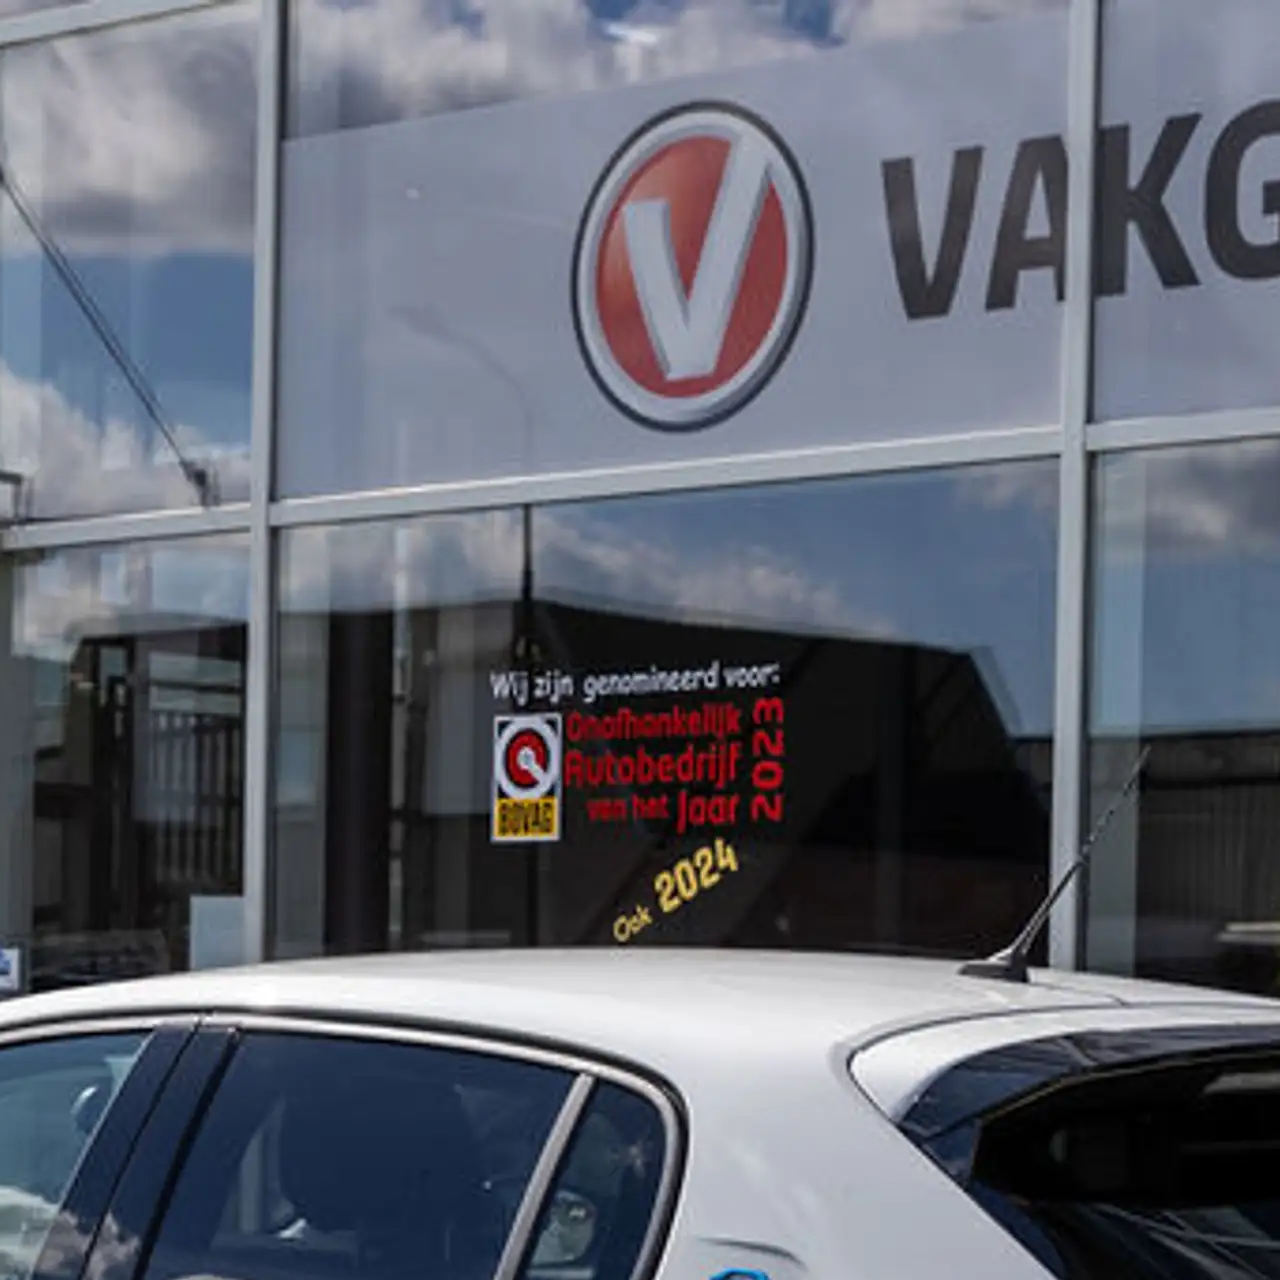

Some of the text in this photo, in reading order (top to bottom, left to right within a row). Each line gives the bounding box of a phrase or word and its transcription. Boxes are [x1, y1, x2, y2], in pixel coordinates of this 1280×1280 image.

[489, 669, 529, 705] Wij
[533, 668, 574, 704] zijn
[583, 660, 719, 702] genomineerd
[566, 702, 742, 742] Onafhankelijk
[563, 742, 742, 788] Autobedrijf
[750, 696, 785, 822] 2023
[631, 792, 670, 820] het
[653, 837, 739, 914] 2024
